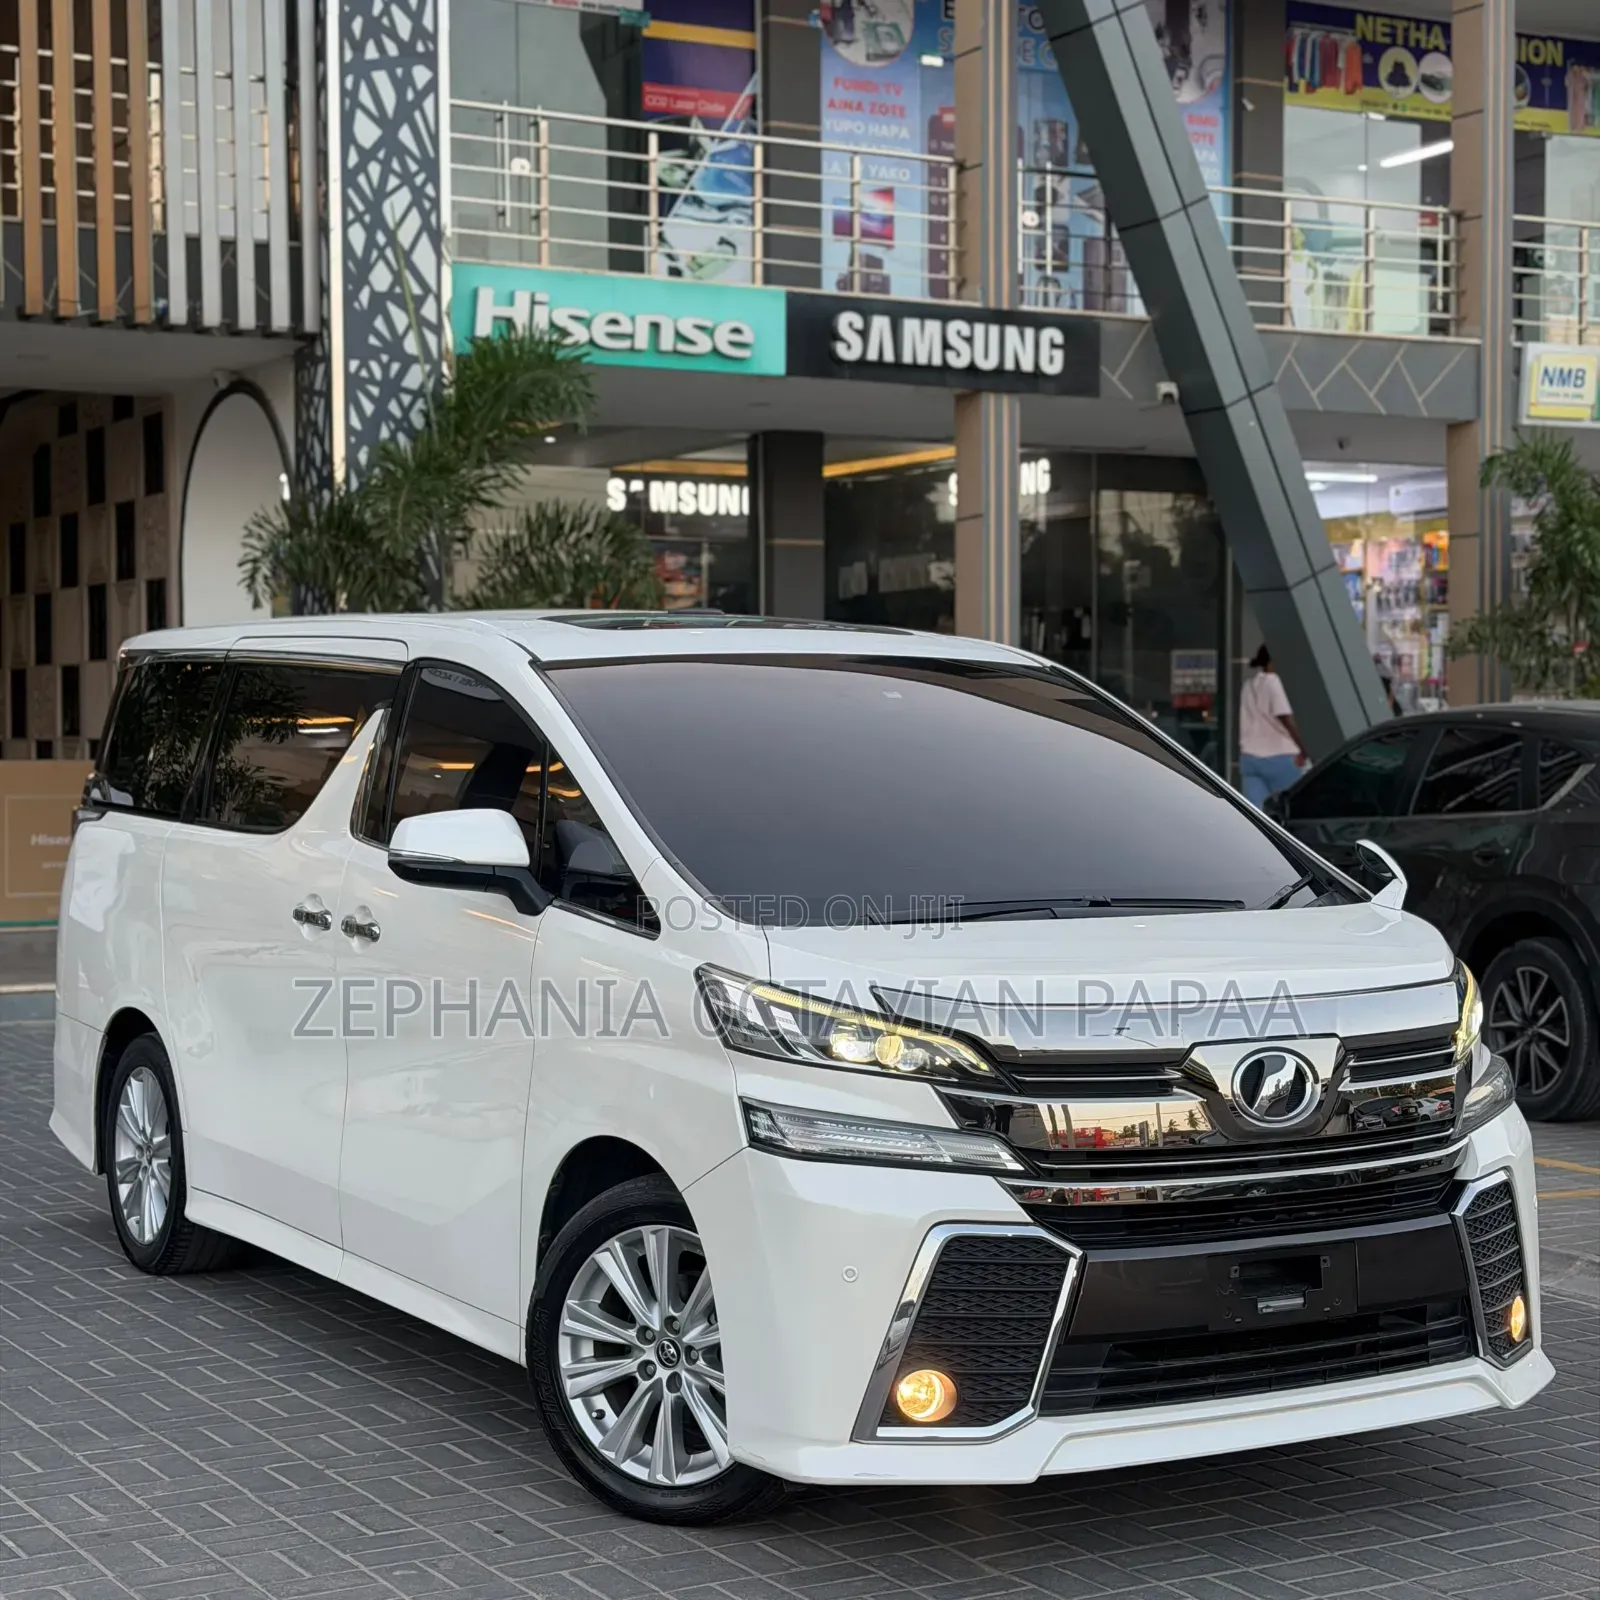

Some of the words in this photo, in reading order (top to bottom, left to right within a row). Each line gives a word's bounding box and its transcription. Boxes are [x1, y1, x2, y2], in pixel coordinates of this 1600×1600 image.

[1355, 13, 1446, 51] NETHA
[883, 82, 904, 97] TV
[827, 98, 865, 114] AINA
[868, 101, 907, 120] ZOTE
[868, 122, 911, 141] HAPA
[867, 163, 911, 183] YAKO
[473, 285, 756, 361] Hisense
[832, 310, 1066, 377] SAMSUNG
[1540, 366, 1587, 389] NMB
